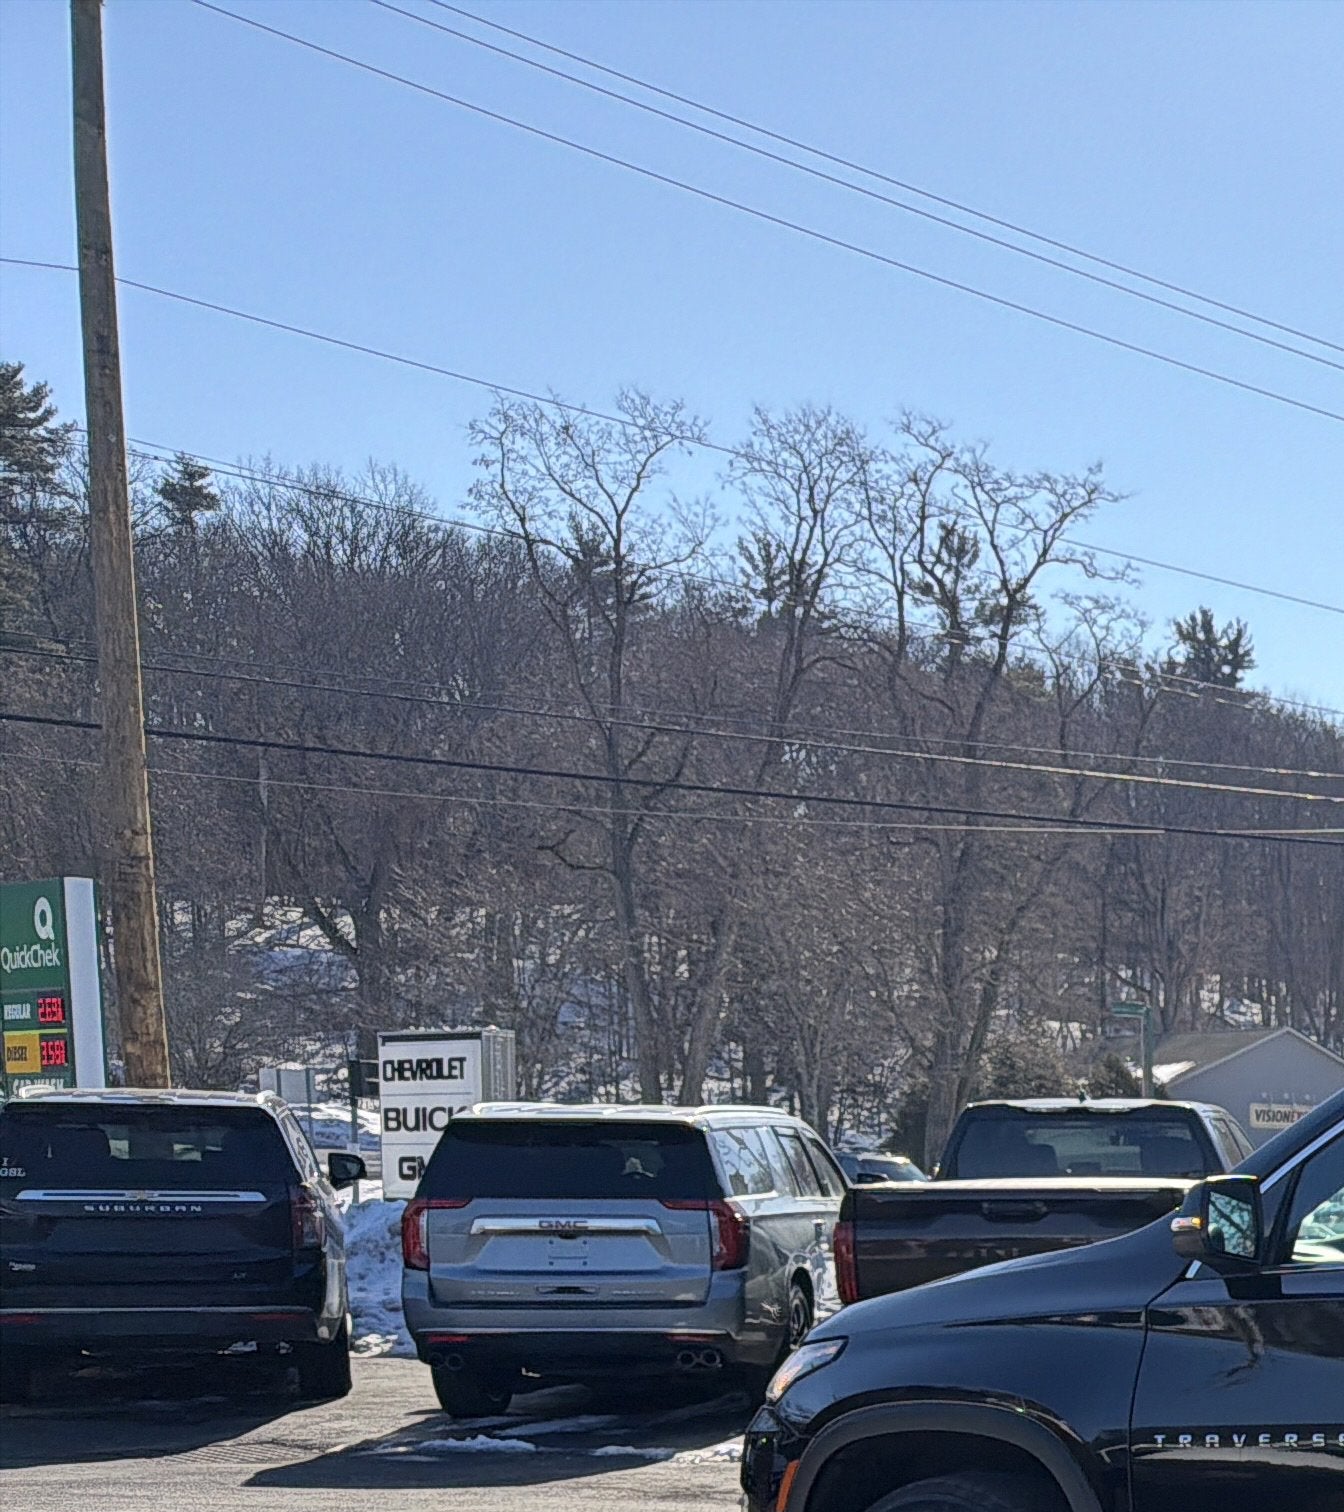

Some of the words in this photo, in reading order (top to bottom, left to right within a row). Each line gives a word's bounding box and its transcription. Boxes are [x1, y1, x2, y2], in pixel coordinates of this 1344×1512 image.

[34, 896, 55, 940] Q
[1, 942, 60, 973] QuickChek
[382, 1056, 467, 1082] CHEVROLET
[538, 1220, 589, 1230] GMC
